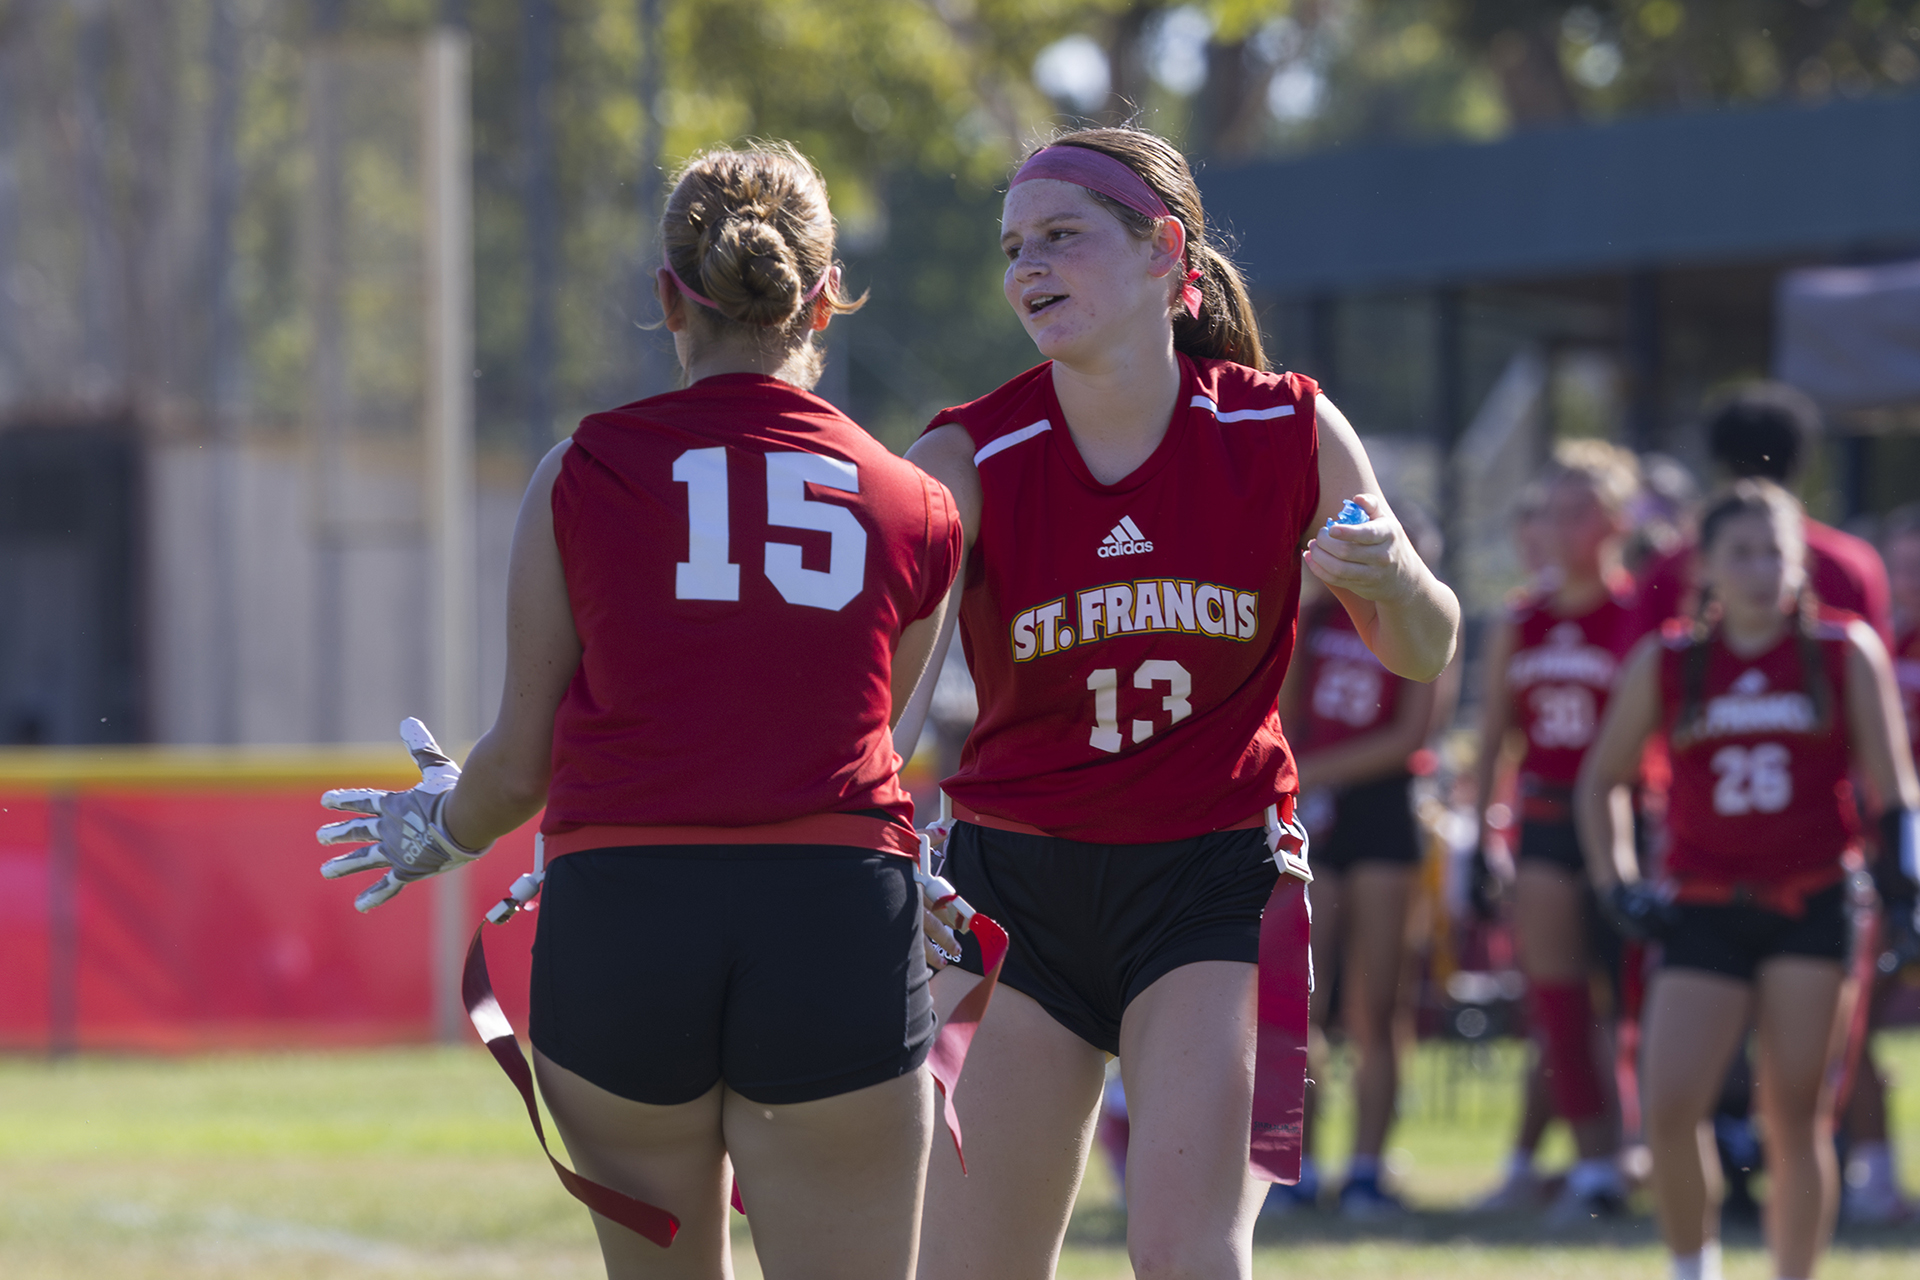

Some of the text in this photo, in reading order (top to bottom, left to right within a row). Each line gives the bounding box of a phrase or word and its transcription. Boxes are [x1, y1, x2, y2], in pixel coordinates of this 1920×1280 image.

[672, 446, 867, 612] 15
[1097, 540, 1154, 558] adidas
[1011, 577, 1259, 663] ST. FRANCIS
[1087, 659, 1192, 753] 13
[1711, 742, 1793, 815] 26
